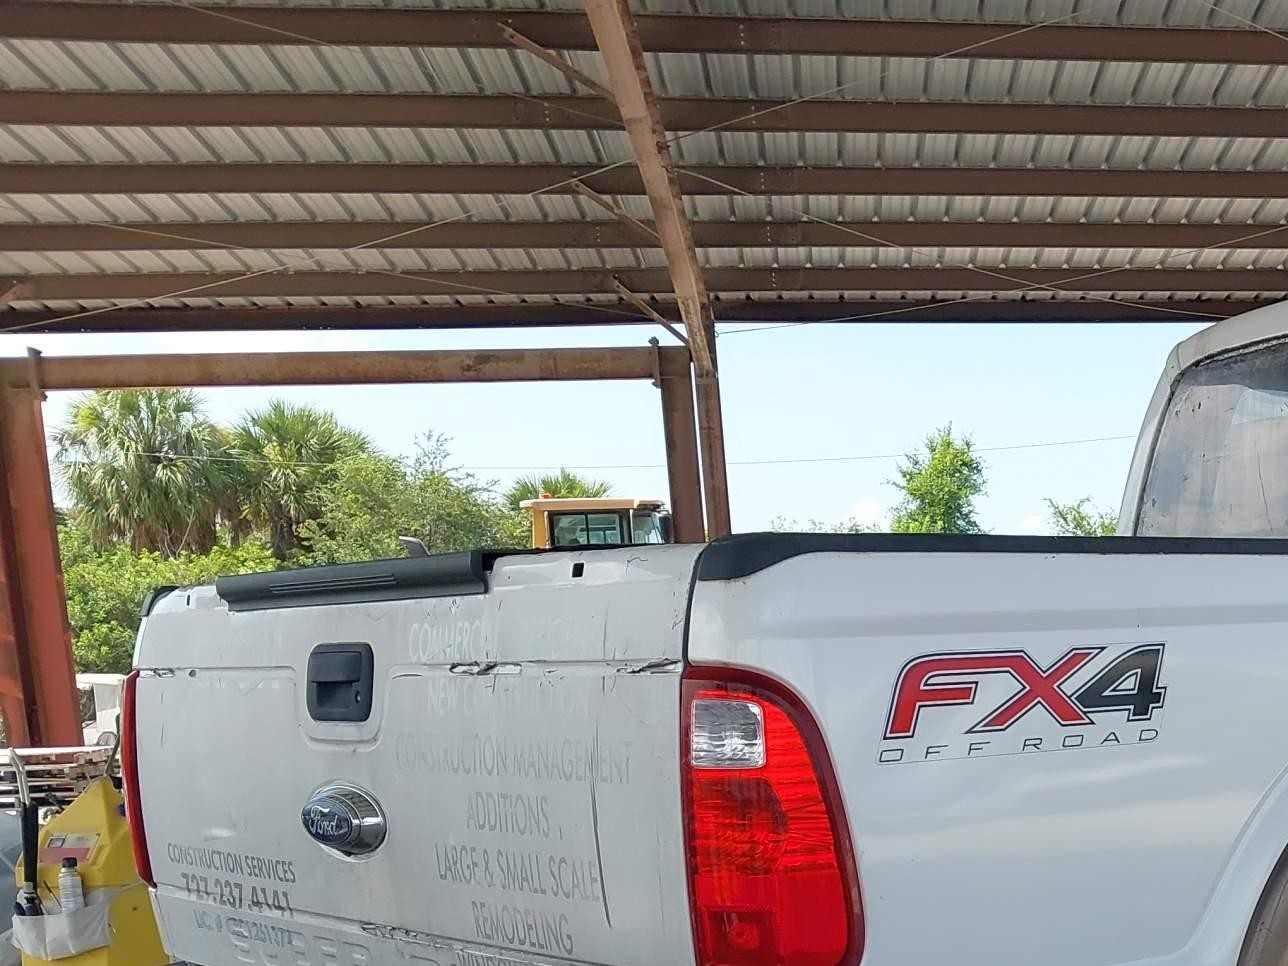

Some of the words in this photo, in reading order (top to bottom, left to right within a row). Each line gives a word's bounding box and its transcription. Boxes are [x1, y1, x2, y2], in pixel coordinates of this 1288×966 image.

[883, 642, 1167, 740] FX4
[309, 805, 338, 836] Ford
[467, 791, 551, 840] ADDITIONS
[167, 842, 244, 876] CONSTRUCTION
[244, 855, 296, 884] SERVICES
[435, 842, 480, 886] LARGE
[496, 848, 547, 895] SMALL
[549, 855, 600, 902] SCALE
[471, 900, 574, 955] REMODELING
